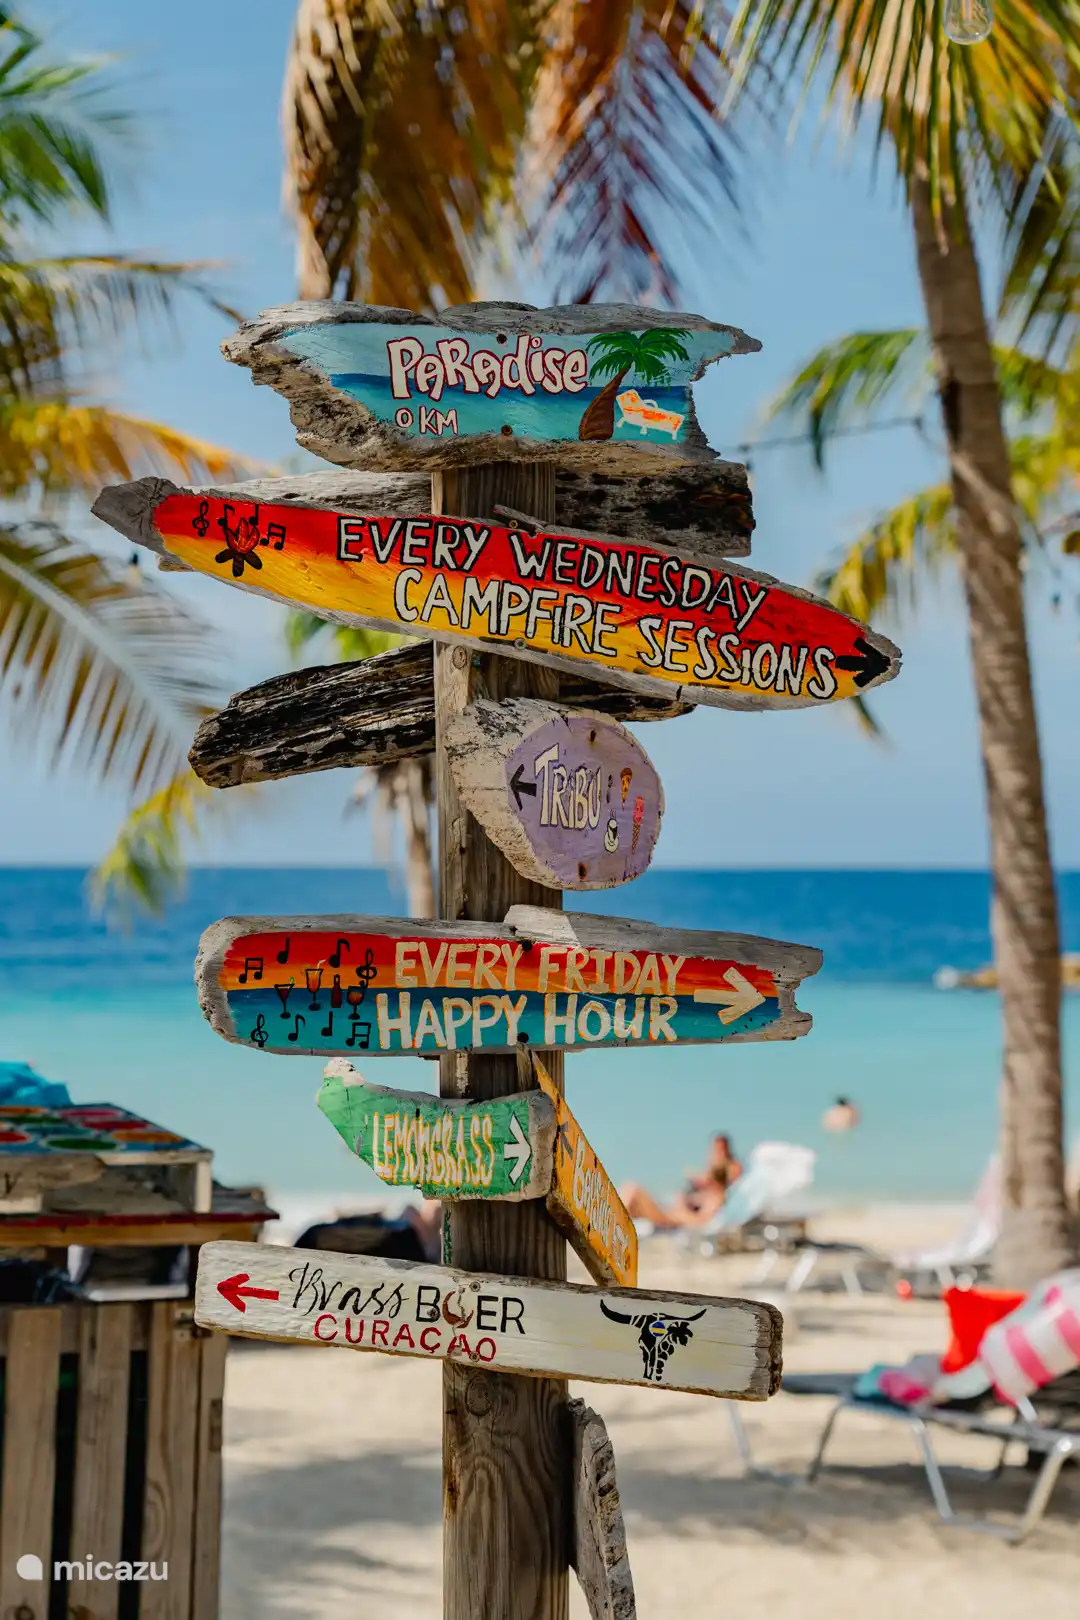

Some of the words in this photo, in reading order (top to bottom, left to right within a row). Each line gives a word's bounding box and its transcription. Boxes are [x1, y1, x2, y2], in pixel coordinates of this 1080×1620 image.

[419, 406, 459, 435] KM
[337, 516, 490, 571] EVERY
[510, 533, 769, 632] WEDNESDAY
[394, 567, 621, 657] CAMPFIRE
[636, 616, 838, 700] SESSIONS
[394, 941, 523, 989] EVERY
[537, 945, 687, 996] FRIDAY
[376, 991, 527, 1050] HAPPY
[543, 993, 679, 1045] HOUR
[372, 1112, 495, 1188] LEMONGRASS
[288, 1262, 410, 1318] Brass
[313, 1313, 497, 1363] CURAÇAO
